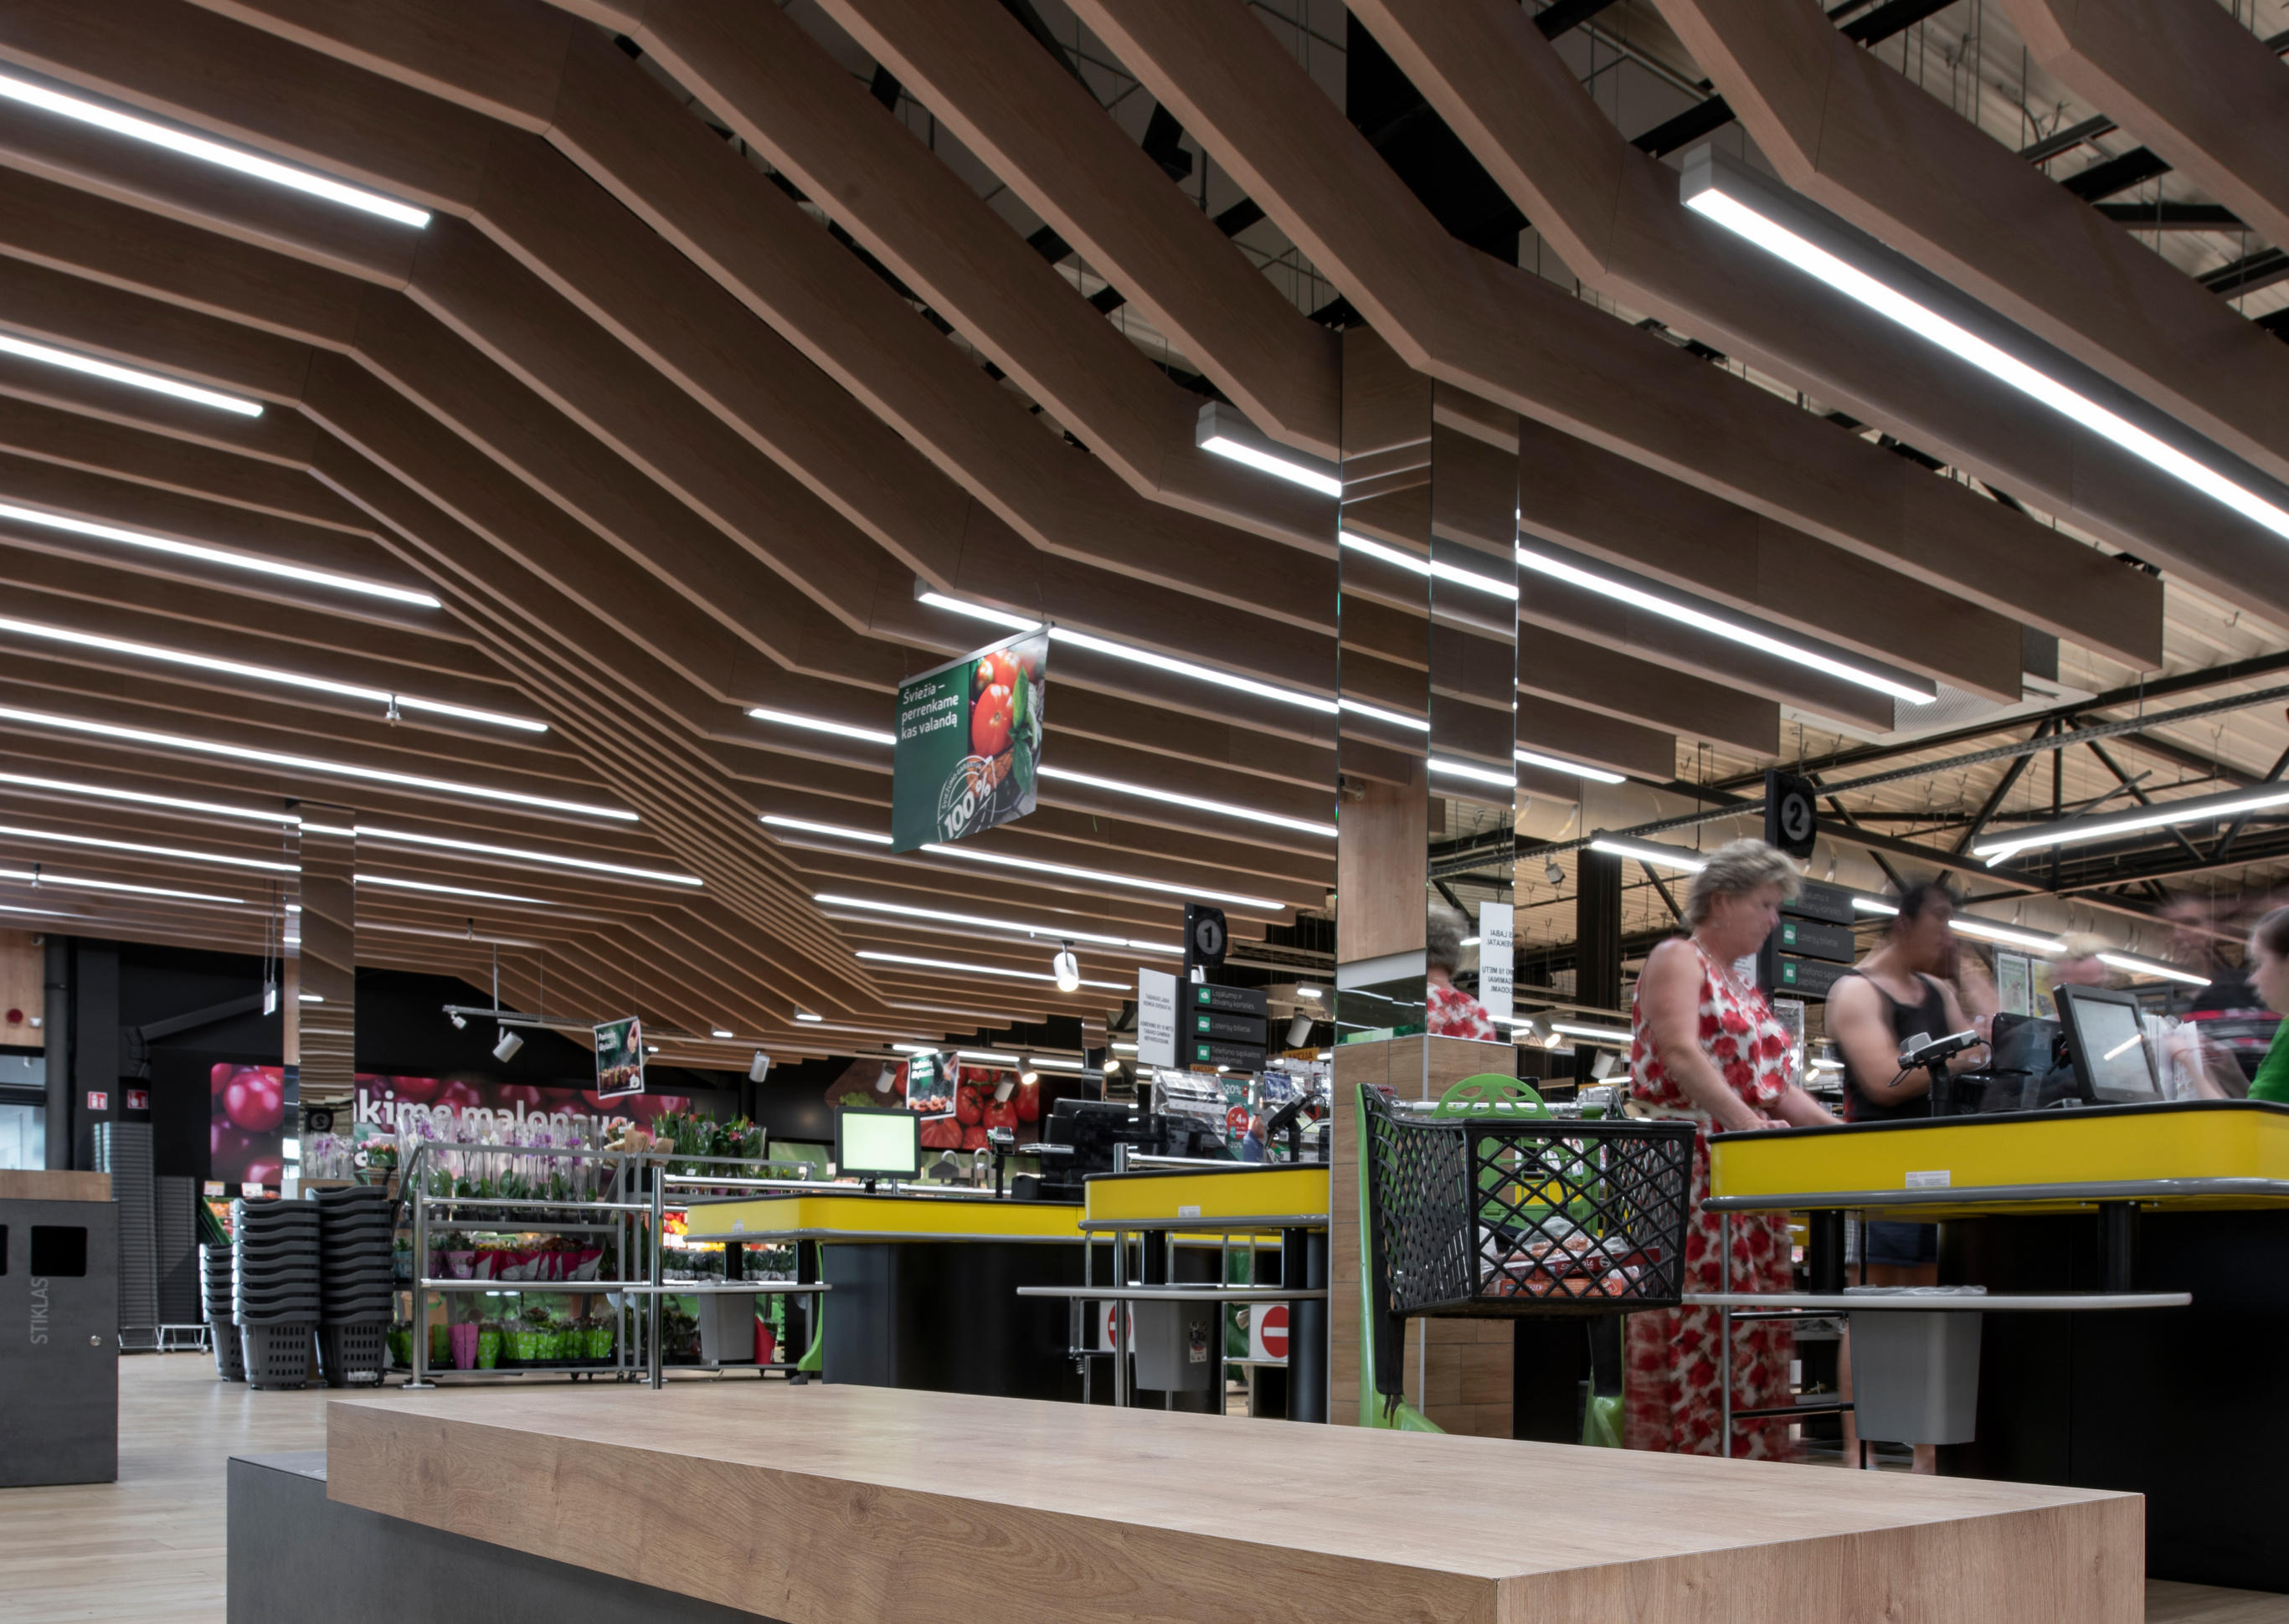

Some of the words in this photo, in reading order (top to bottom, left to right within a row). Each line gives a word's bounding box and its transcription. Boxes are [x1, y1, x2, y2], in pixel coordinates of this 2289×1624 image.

[903, 682, 936, 705] Šviežia
[901, 725, 918, 740] kas
[918, 711, 958, 734] valandą
[902, 694, 959, 726] perrenkame
[944, 772, 990, 839] 100%
[1789, 801, 1803, 832] 2
[1204, 925, 1213, 948] 1
[352, 1088, 453, 1127] kime
[30, 1277, 49, 1344] STIKLAS
